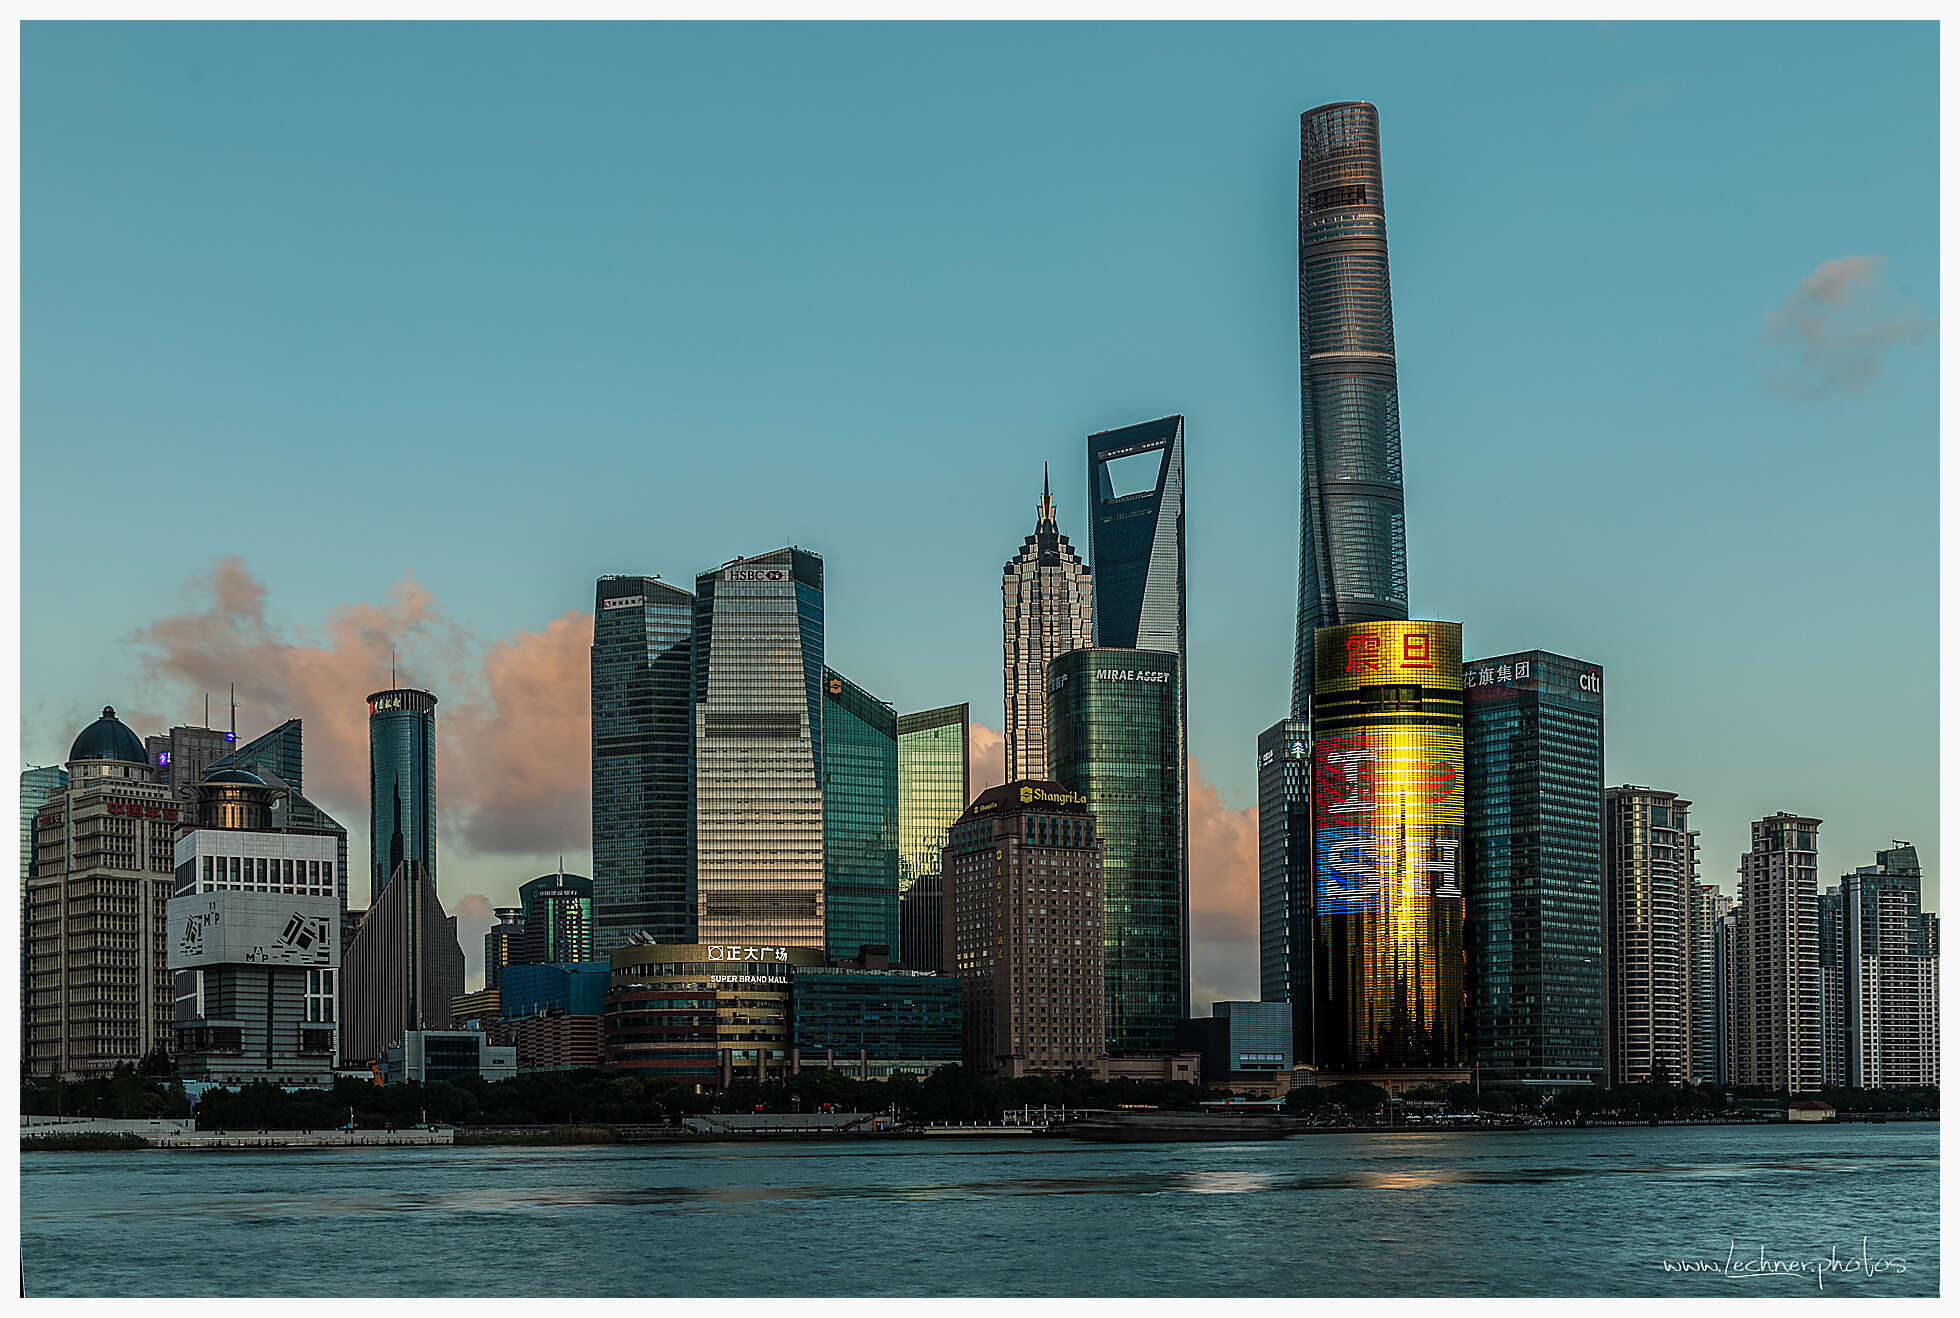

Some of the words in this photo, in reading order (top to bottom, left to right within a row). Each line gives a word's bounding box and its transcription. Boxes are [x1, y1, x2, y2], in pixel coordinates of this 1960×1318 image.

[730, 570, 765, 581] HSBC
[1346, 634, 1433, 672] 震旦
[1096, 669, 1134, 681] MIRAE
[1136, 670, 1170, 683] ASSET
[1462, 661, 1530, 688] 花旗集团
[1579, 671, 1600, 693] citi
[1033, 788, 1087, 806] Shangri-La
[107, 803, 179, 820] 中国平安
[726, 946, 788, 962] 正大广场
[711, 975, 738, 983] SUPER
[740, 975, 767, 983] BRAND
[768, 976, 788, 984] MALL
